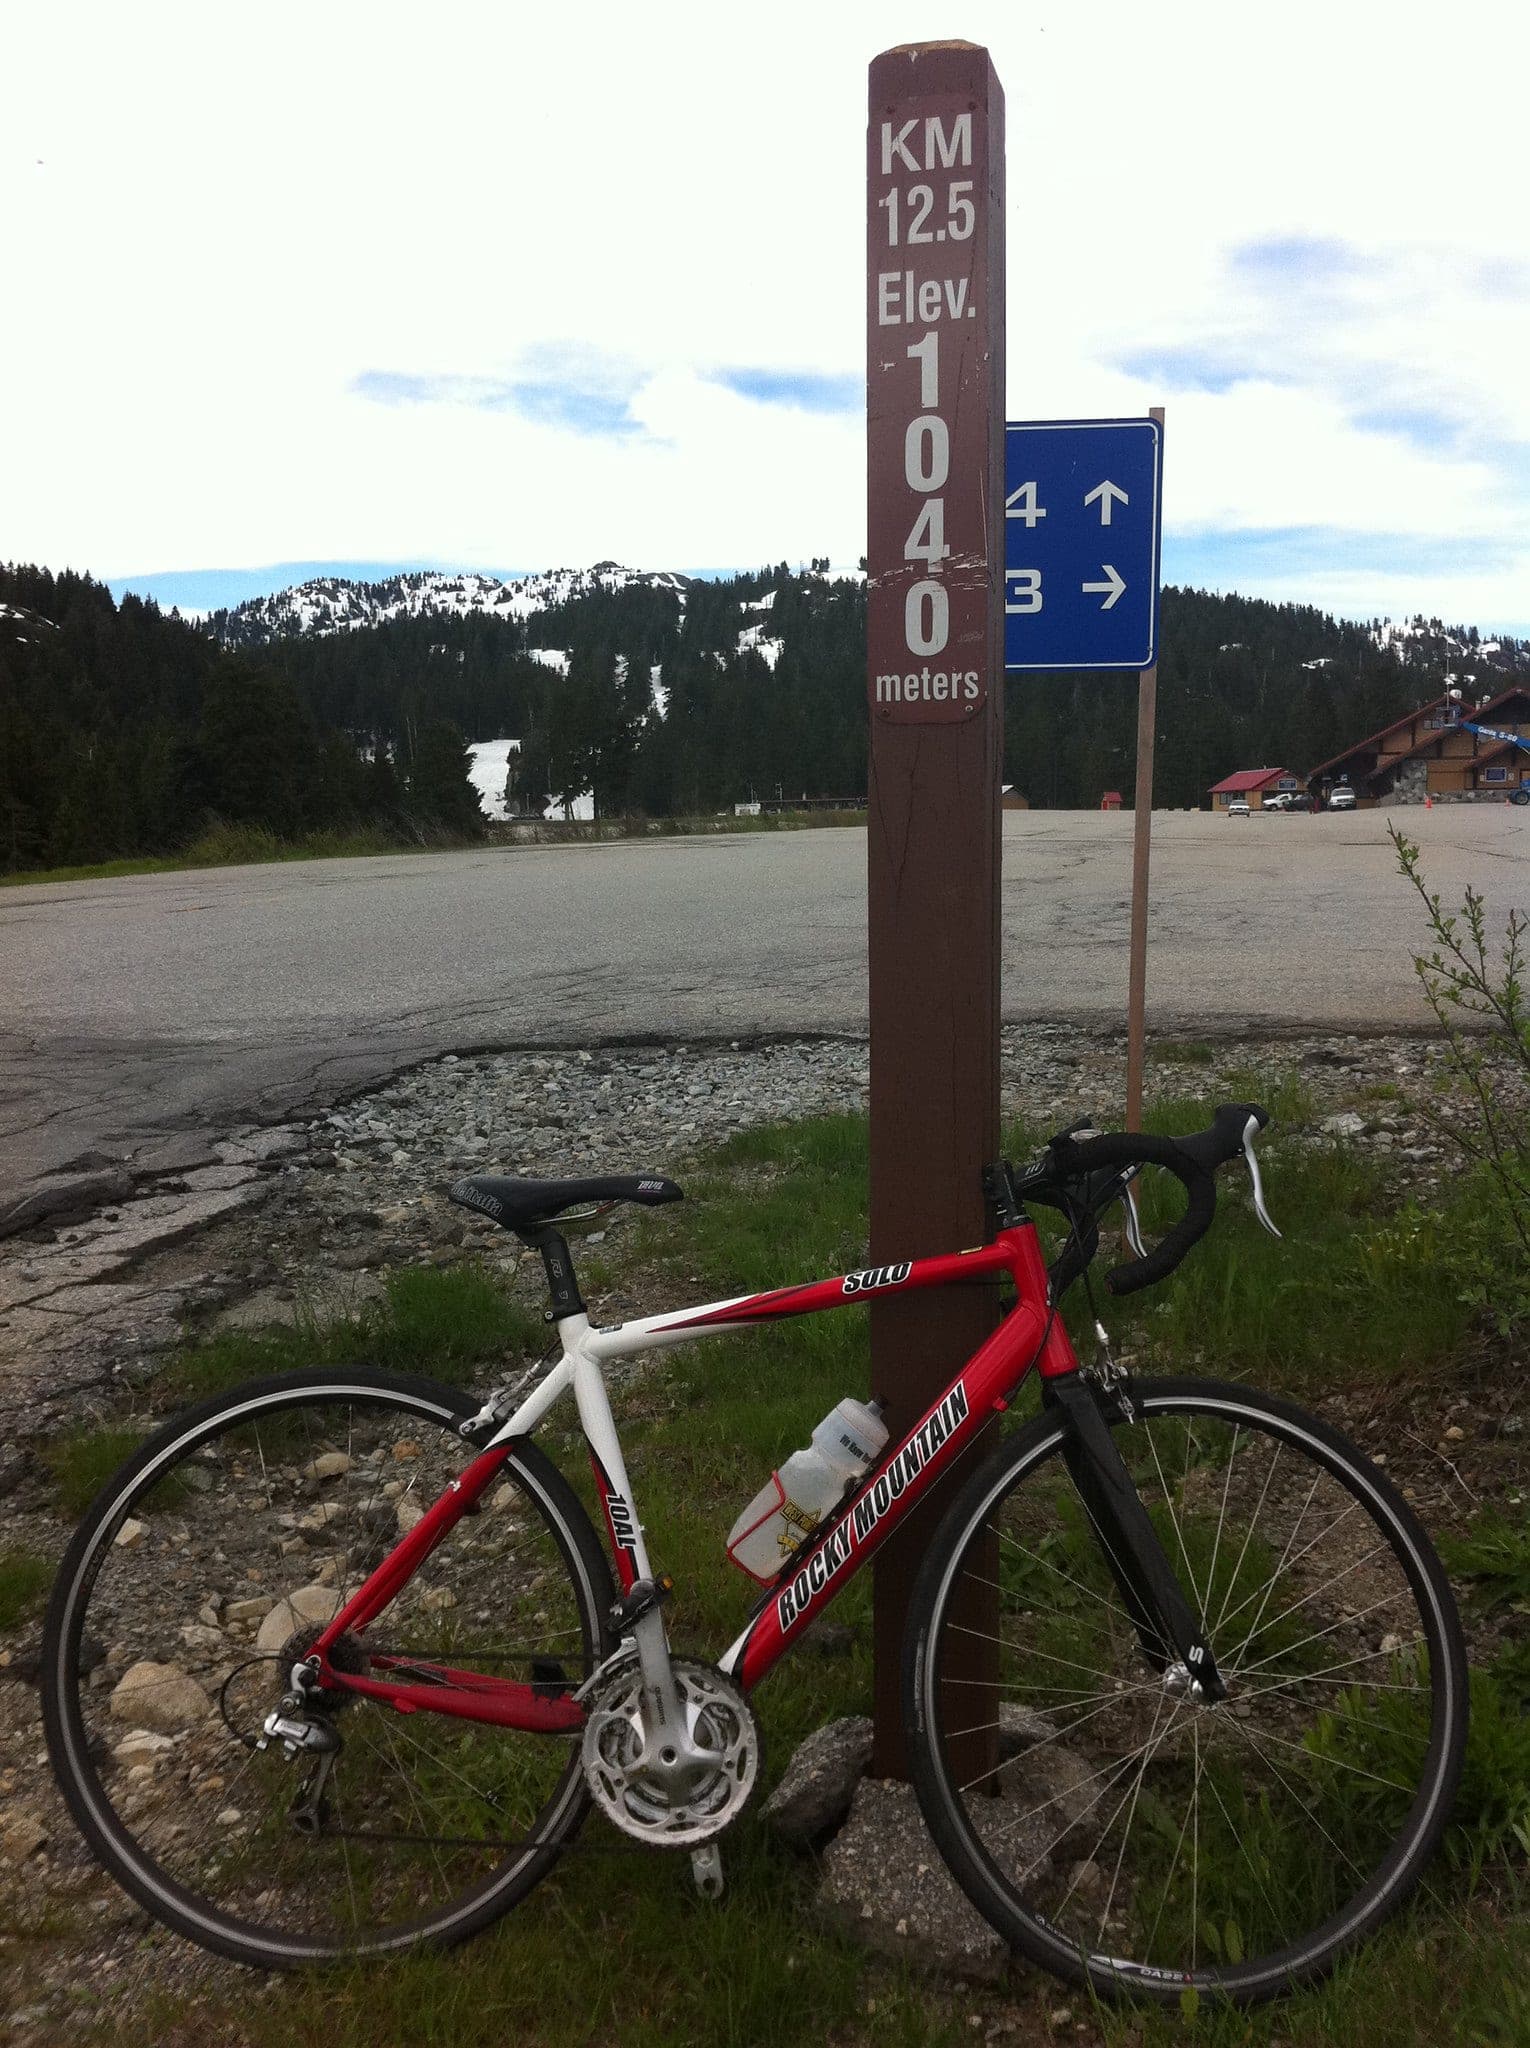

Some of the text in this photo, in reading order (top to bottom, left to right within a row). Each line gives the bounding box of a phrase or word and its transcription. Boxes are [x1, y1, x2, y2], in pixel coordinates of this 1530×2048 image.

[881, 113, 972, 174] KM
[878, 181, 975, 246] 12.5
[878, 270, 976, 325] Elev.
[1005, 481, 1047, 527] 4
[1005, 569, 1043, 614] 3
[876, 667, 979, 702] meters
[842, 1262, 912, 1294] SOLO
[778, 1513, 852, 1634] ROCKY
[852, 1379, 969, 1544] MOUNTAIN
